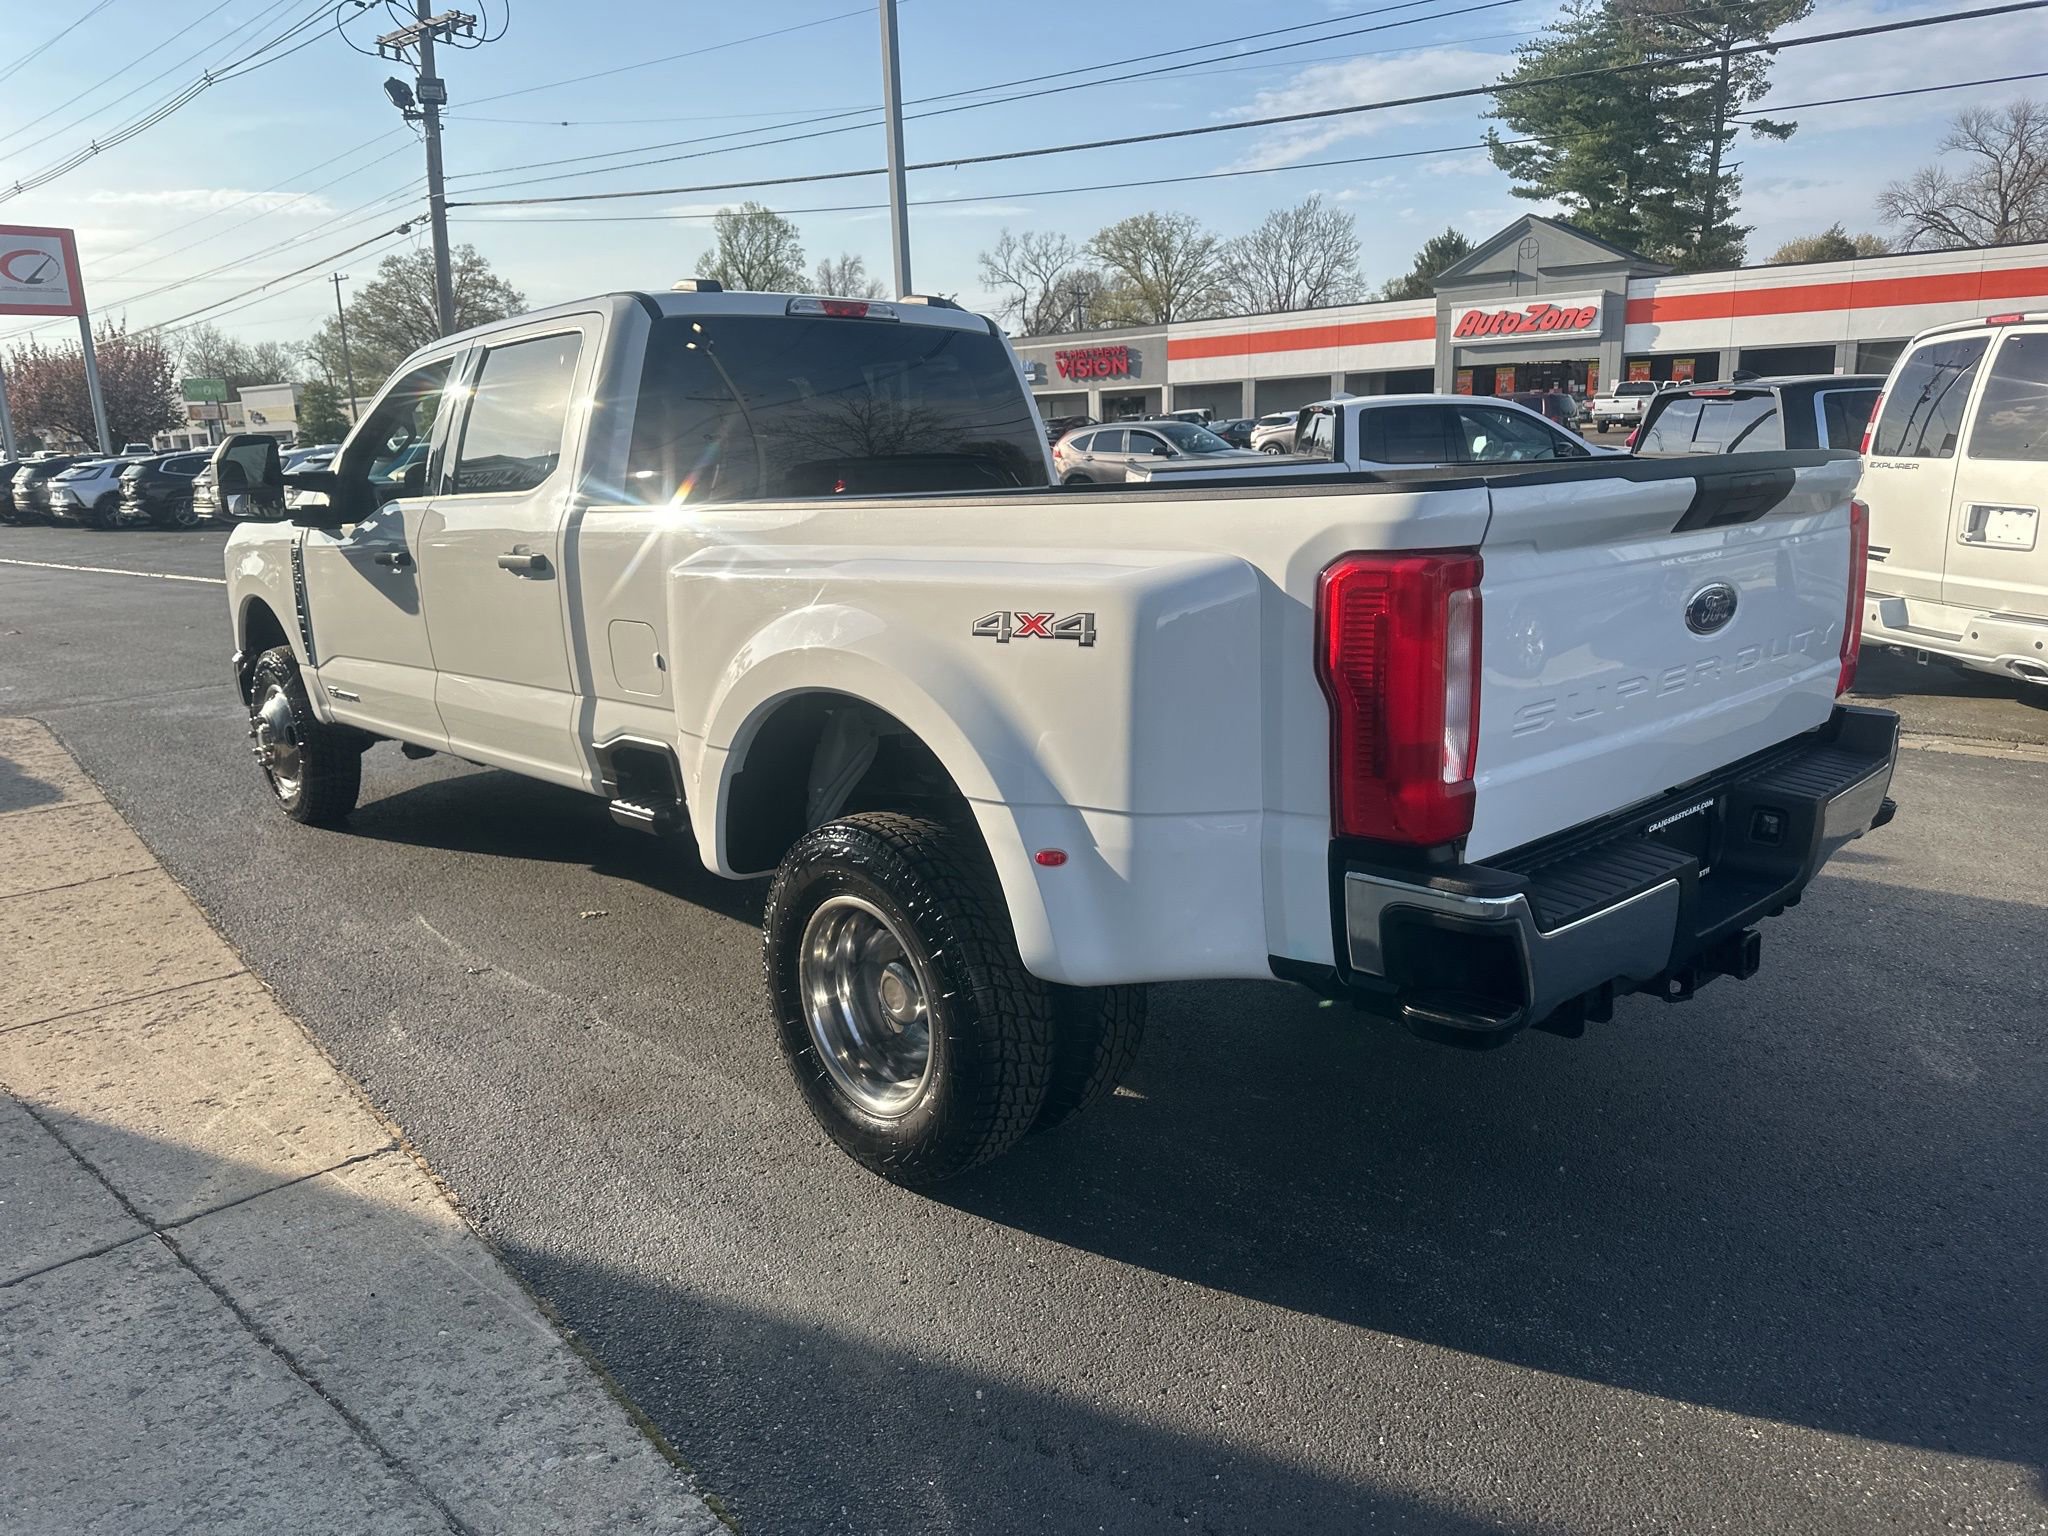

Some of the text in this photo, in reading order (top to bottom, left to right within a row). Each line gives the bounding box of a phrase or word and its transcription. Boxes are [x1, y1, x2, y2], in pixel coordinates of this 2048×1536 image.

[1453, 304, 1597, 338] AutoZone
[1056, 357, 1128, 379] VISION
[1069, 346, 1128, 359] MATTHEWS
[1702, 593, 1729, 624] Ford
[1512, 622, 1836, 739] SUPER DUTY
[1648, 798, 1714, 833] CRAIGSBESTCARS.COM
